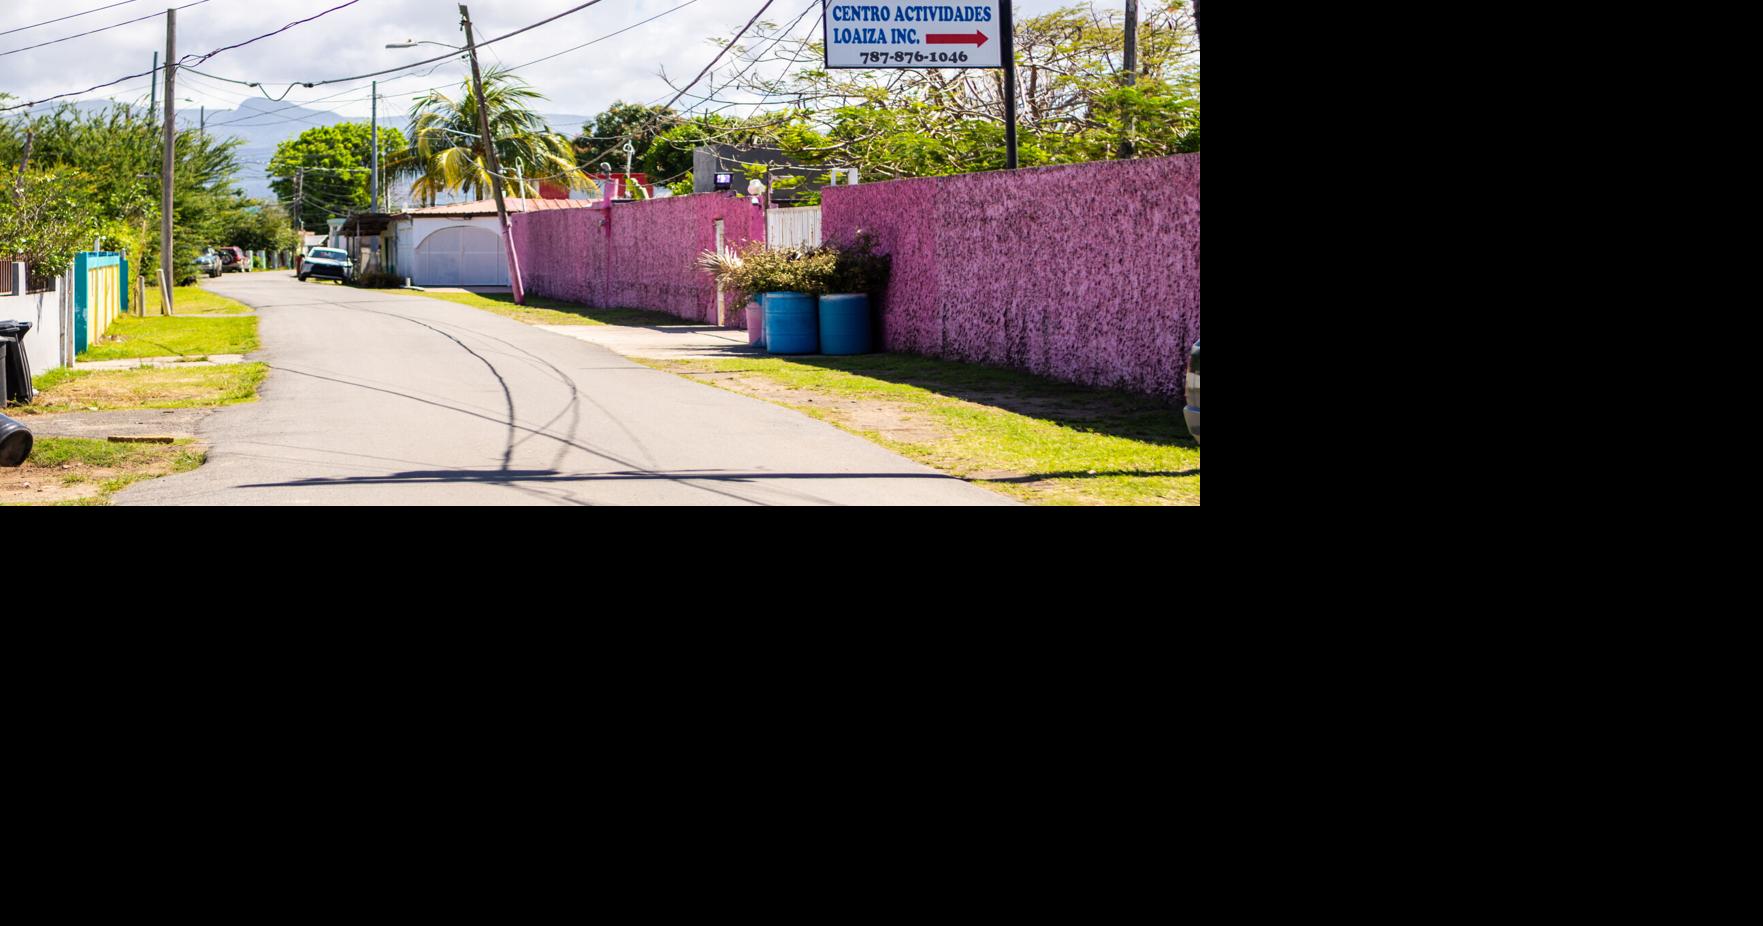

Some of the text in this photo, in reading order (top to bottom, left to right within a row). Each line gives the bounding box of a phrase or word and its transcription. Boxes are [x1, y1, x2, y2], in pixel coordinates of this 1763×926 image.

[832, 5, 992, 22] CENTRO ACTIVIDADES
[833, 27, 920, 45] LOAIZA INC.
[859, 50, 968, 64] 787-876-1046
